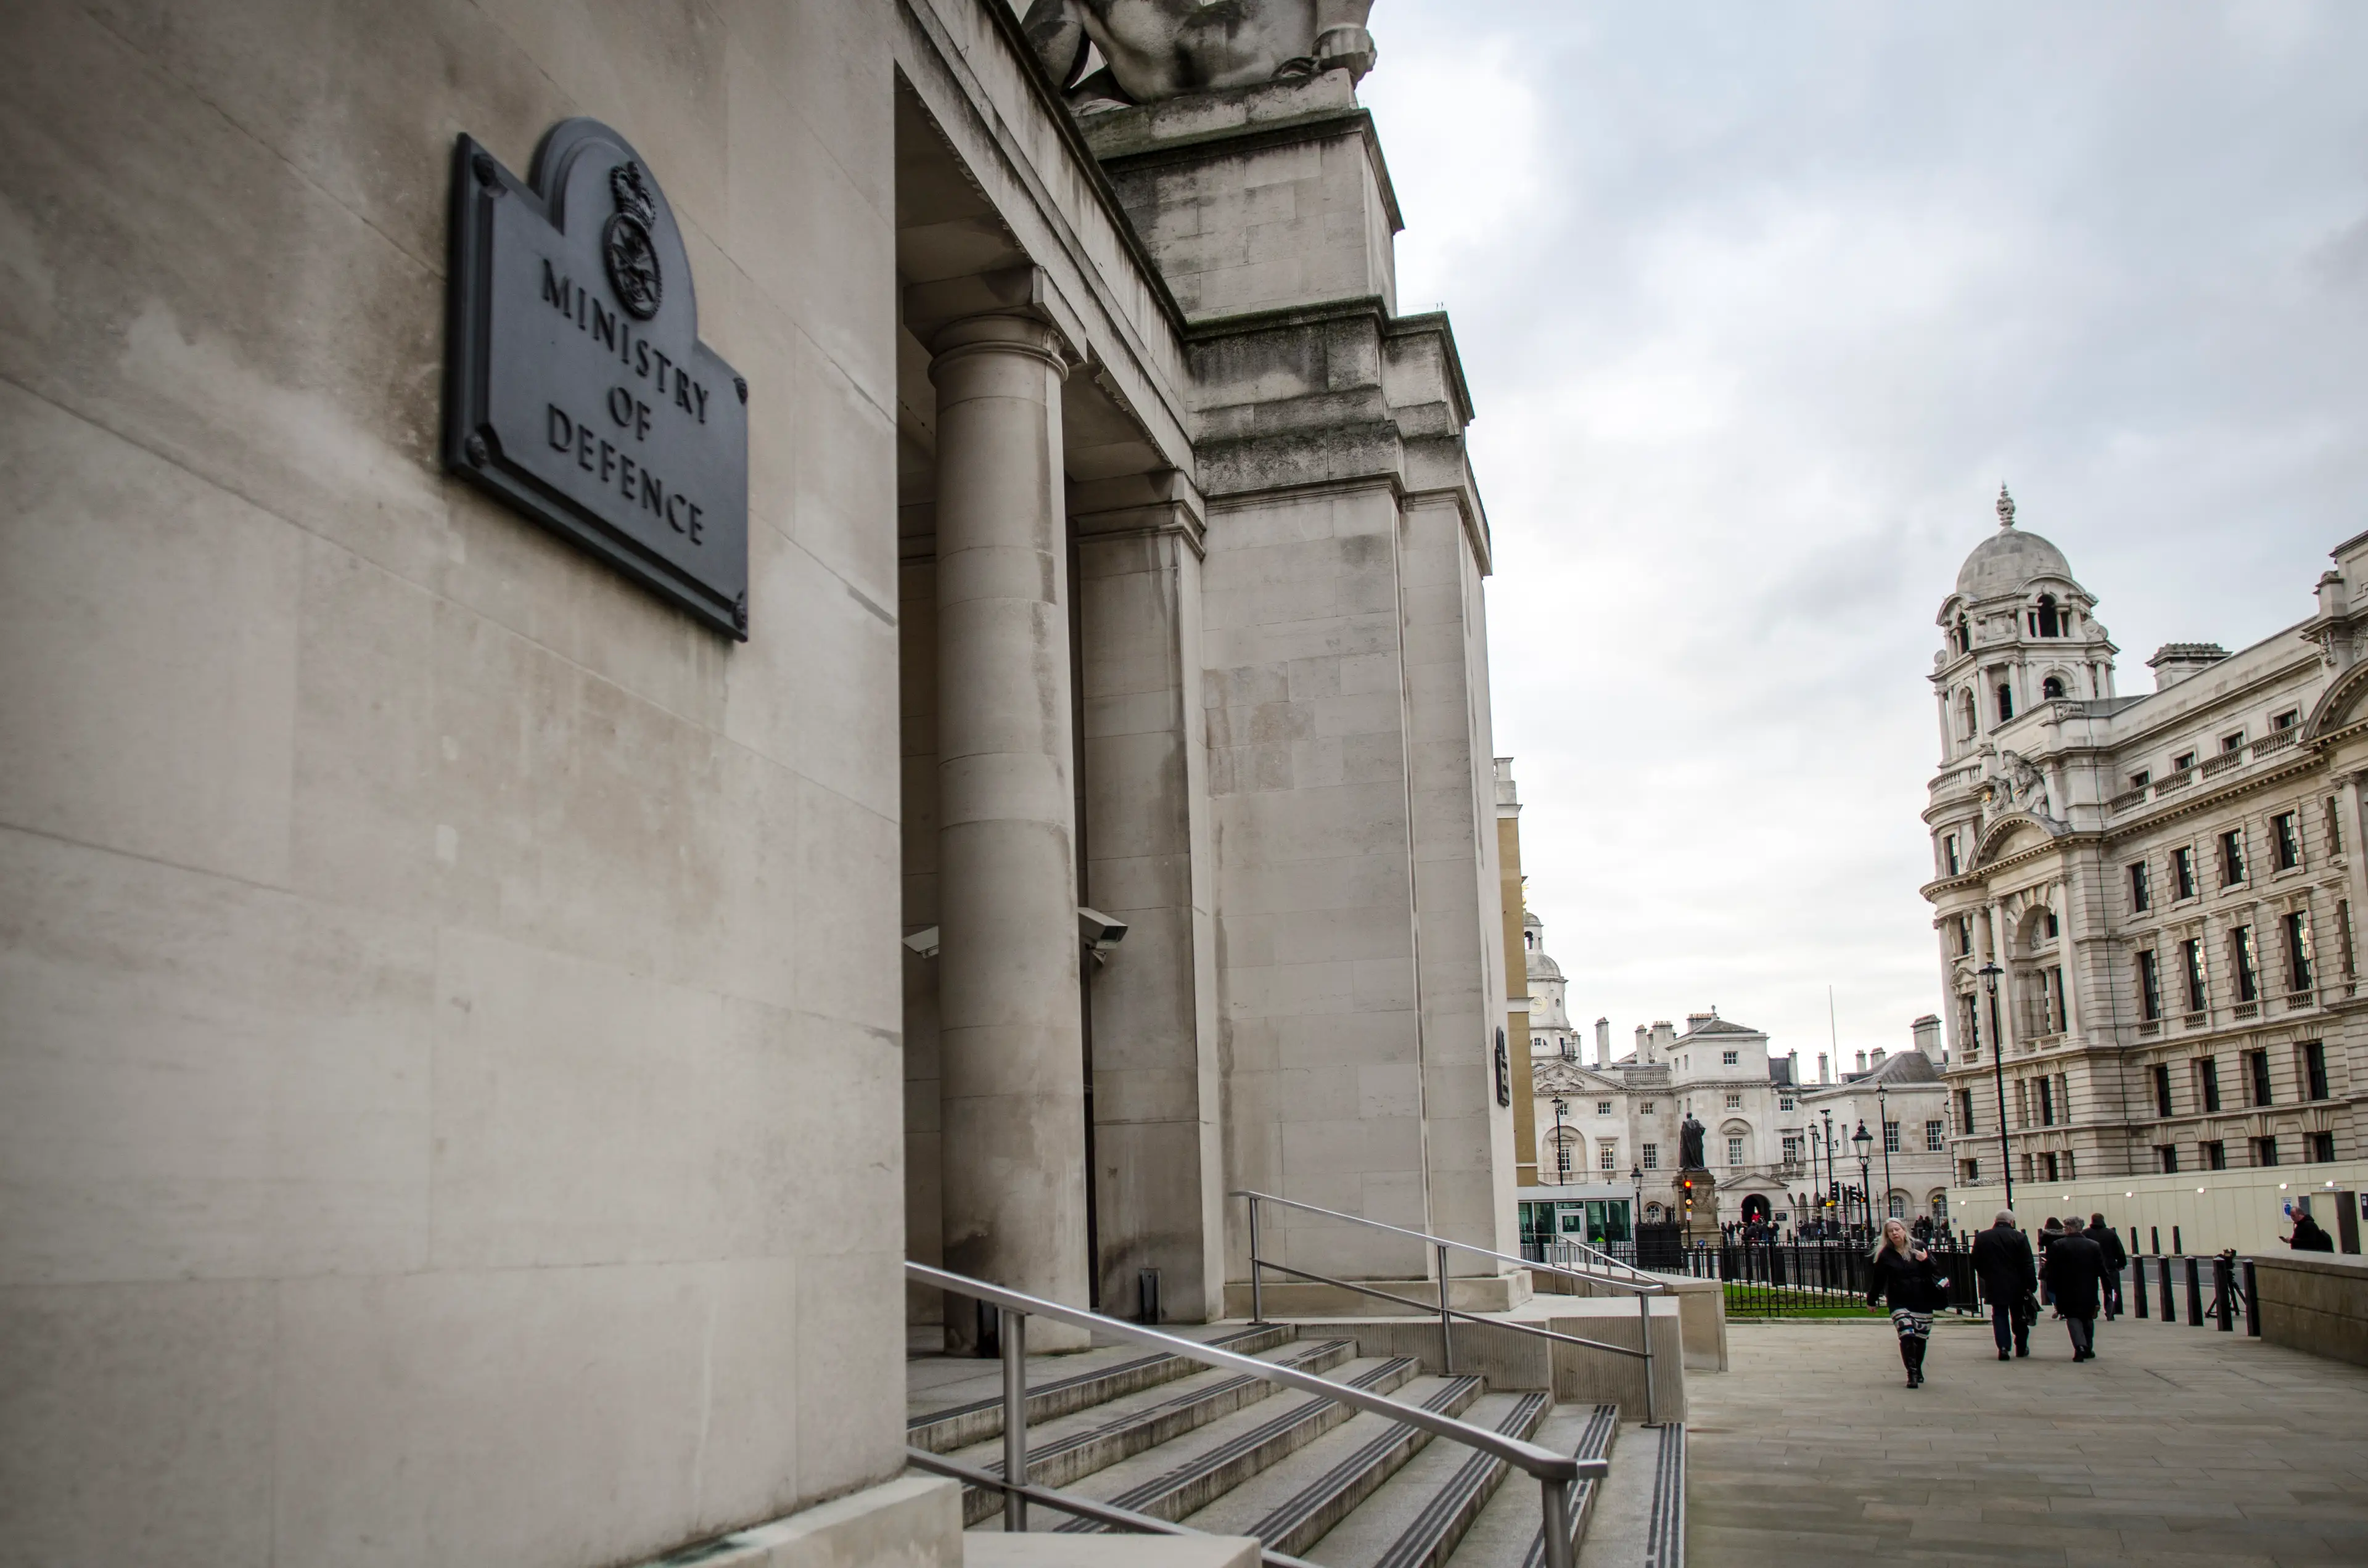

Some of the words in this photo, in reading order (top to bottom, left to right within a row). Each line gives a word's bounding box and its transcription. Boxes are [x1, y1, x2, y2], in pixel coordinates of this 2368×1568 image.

[542, 258, 709, 425] MINISTRY
[547, 403, 704, 546] DEFENCE
[608, 386, 652, 442] OF
